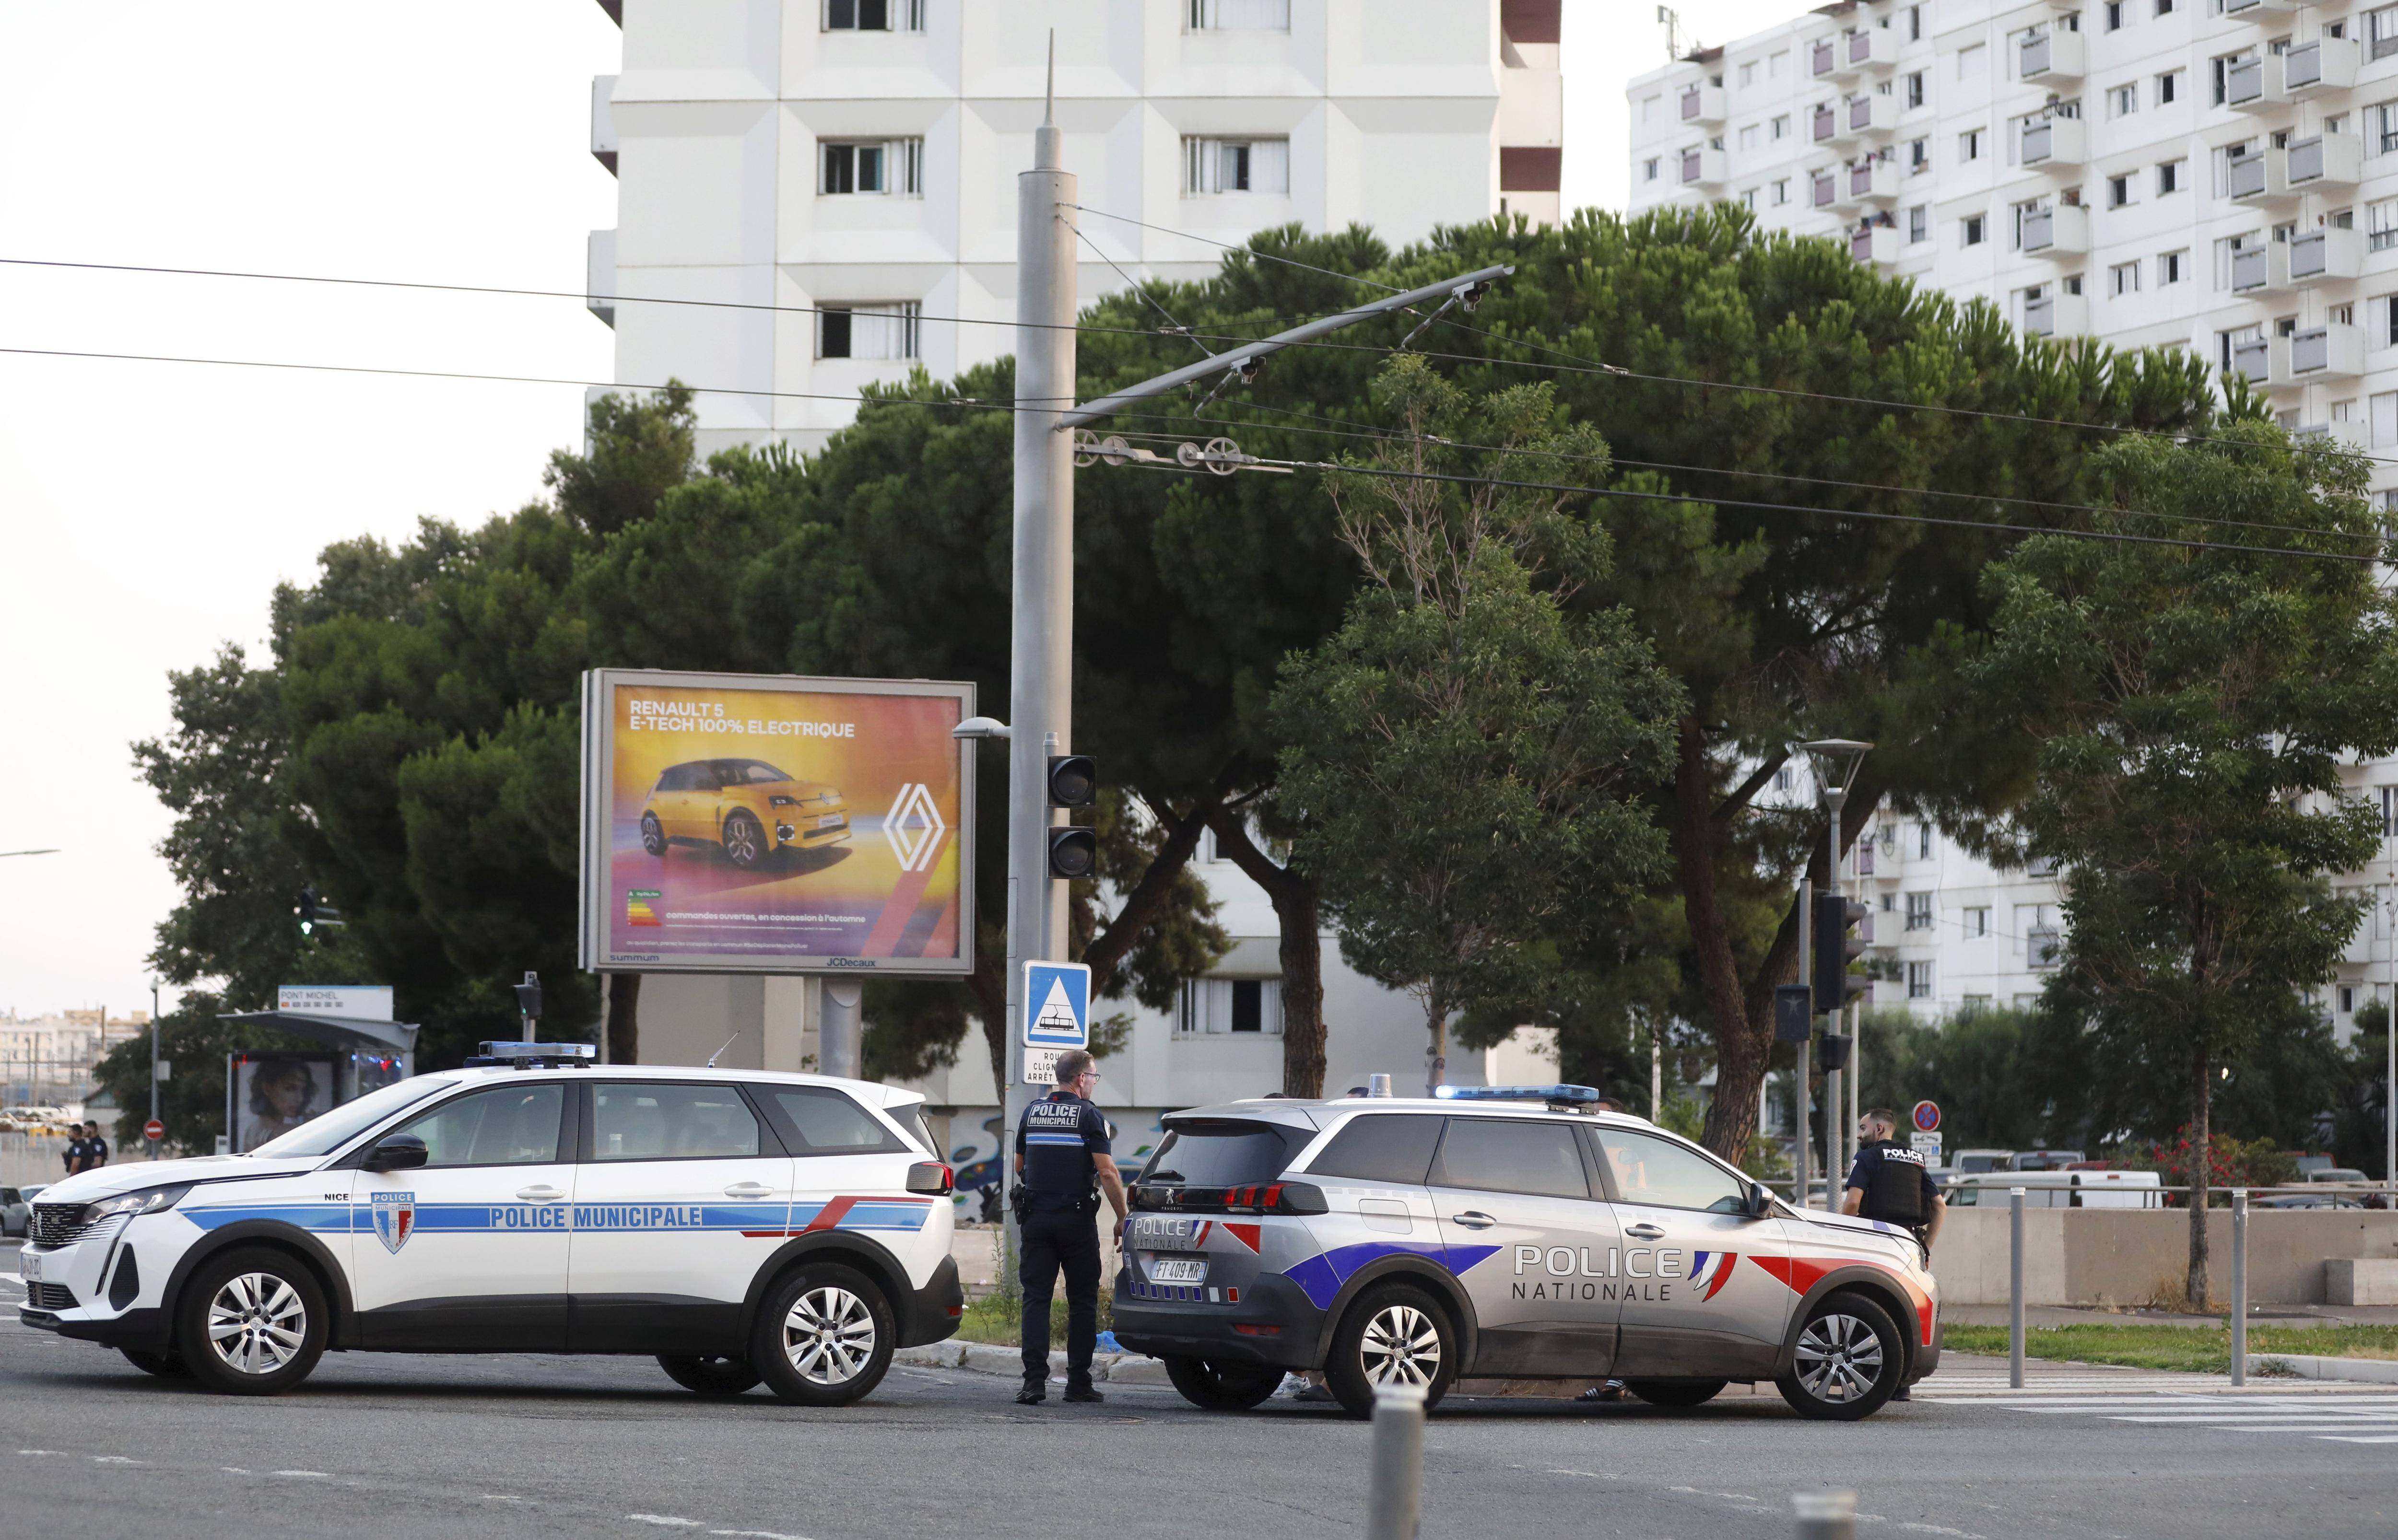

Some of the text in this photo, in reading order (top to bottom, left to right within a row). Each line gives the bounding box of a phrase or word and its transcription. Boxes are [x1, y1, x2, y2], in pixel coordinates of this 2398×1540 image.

[630, 700, 724, 717] RENAULT 5
[630, 716, 855, 738] E-TECH 100% ELECTRIQUE
[719, 913, 757, 922] ouvertes,
[770, 914, 817, 922] concession
[818, 914, 824, 922] à
[825, 914, 866, 922] l'automne
[827, 958, 875, 967] JCDecaux
[1028, 1073, 1052, 1082] ARRÊT
[1031, 1105, 1078, 1117] POLICE
[1030, 1117, 1076, 1125] MUNICIPALE
[1882, 1148, 1923, 1162] POLICE
[491, 1207, 701, 1227] POLICE MUNICIPALE
[389, 1220, 398, 1229] RF
[1135, 1218, 1187, 1237] POLICE
[1134, 1238, 1185, 1250] NATIONALE
[1514, 1245, 1681, 1278] POLICE
[1156, 1261, 1200, 1279] FT-409-MR
[1512, 1282, 1671, 1301] NATIONALE
